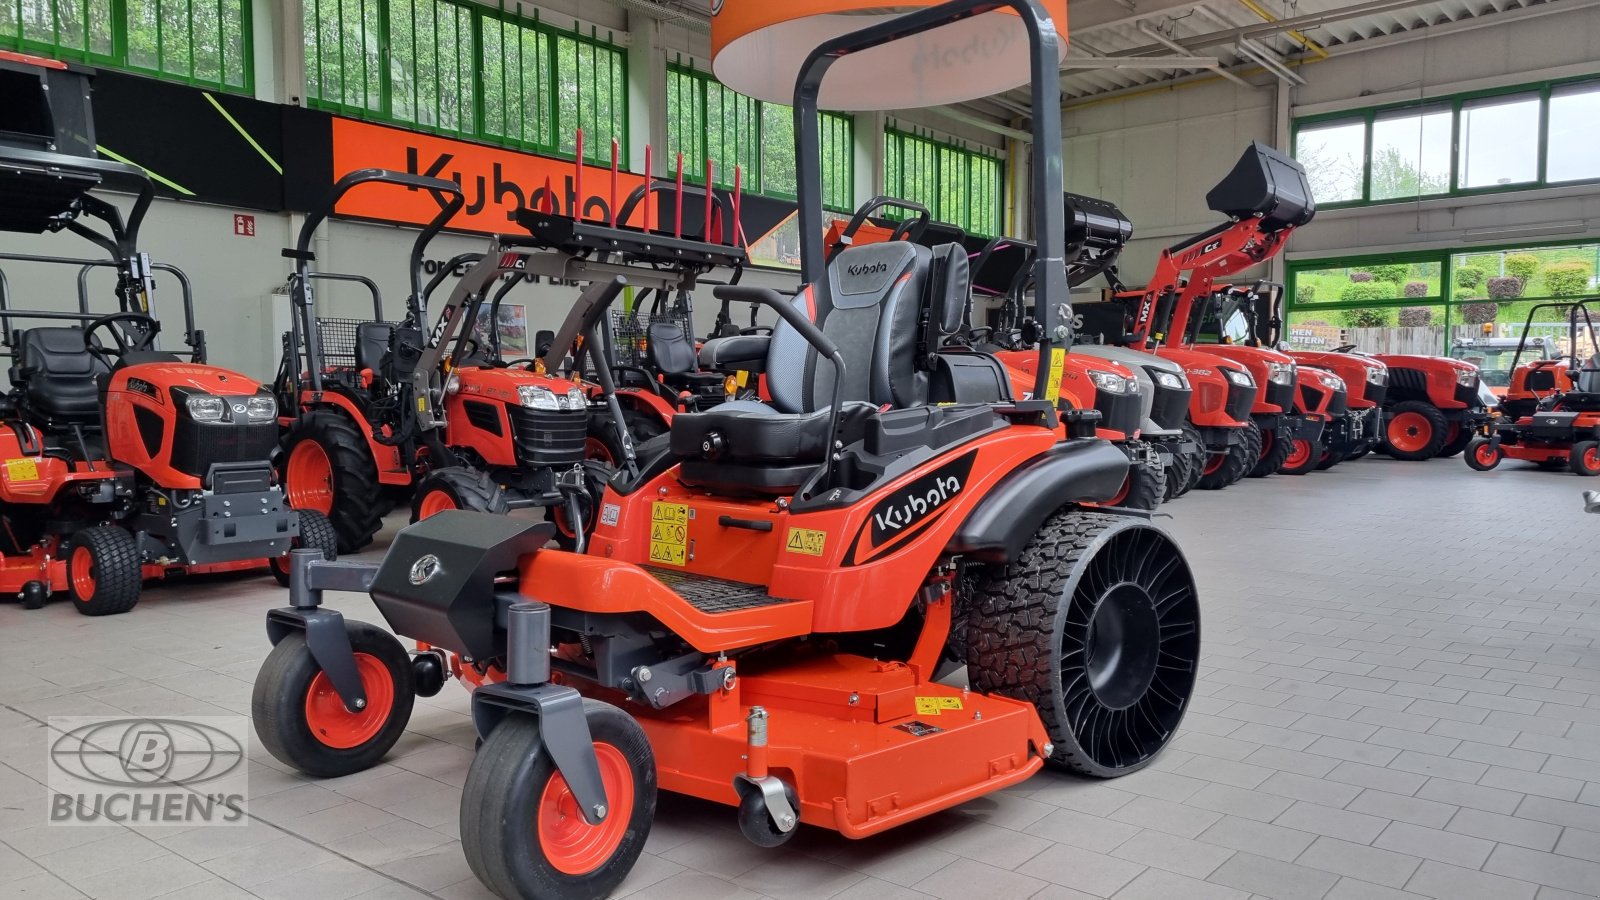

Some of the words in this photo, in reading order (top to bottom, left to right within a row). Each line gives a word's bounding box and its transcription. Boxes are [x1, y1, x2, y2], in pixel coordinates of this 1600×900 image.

[406, 146, 616, 222] Kubota
[848, 261, 887, 276] Kubota
[1140, 301, 1151, 322] MX
[430, 315, 448, 348] MX
[875, 476, 961, 531] Kubota
